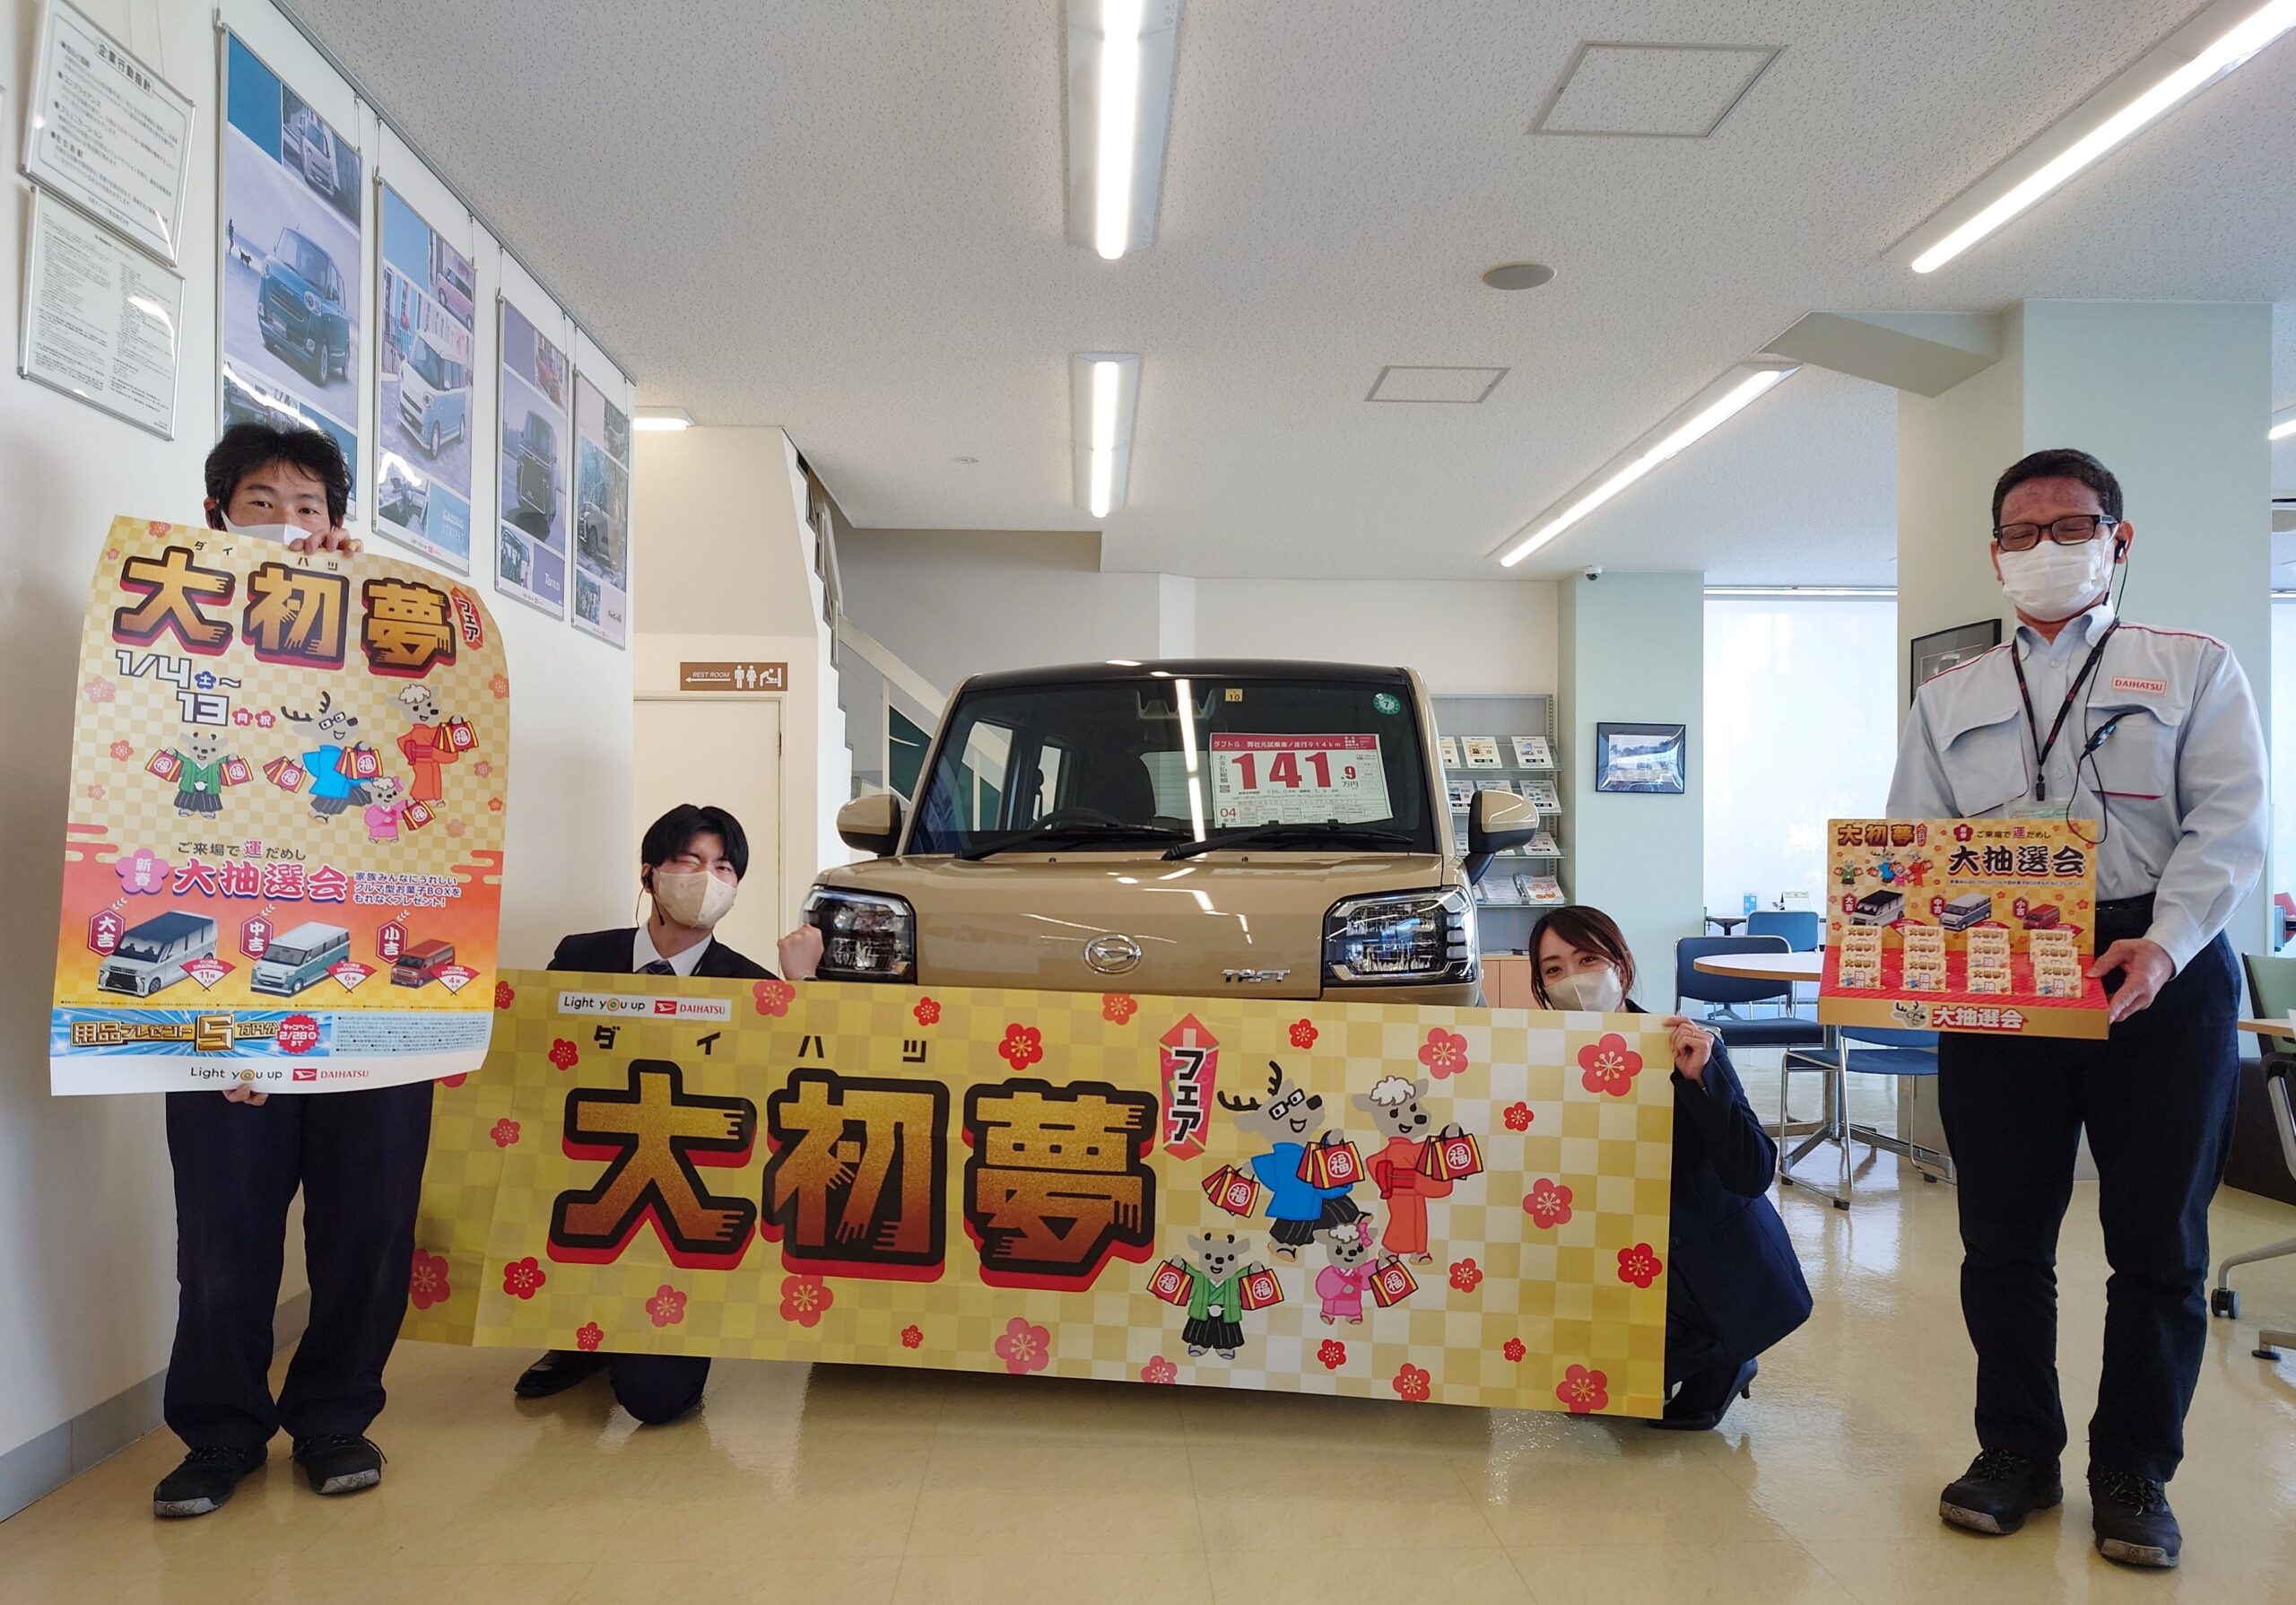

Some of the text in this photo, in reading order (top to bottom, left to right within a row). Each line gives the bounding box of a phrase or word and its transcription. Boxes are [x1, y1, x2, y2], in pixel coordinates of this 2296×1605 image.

[98, 43, 151, 93] 企業行動指針
[2114, 678, 2163, 693] DAIHATSU
[1220, 807, 1237, 818] 04
[1948, 845, 2086, 877] 大抽選会
[173, 858, 347, 903] 大抽選会
[97, 916, 117, 948] 大吉
[248, 921, 265, 952] 中吉
[384, 927, 400, 956] 小吉
[564, 996, 646, 1012] Light you up
[680, 1004, 726, 1015] DAIHATSU
[1932, 1007, 2024, 1030] 大抽選会
[190, 1067, 283, 1082] Light you up
[320, 1069, 370, 1079] DAIHATSU
[1331, 1155, 1351, 1176] 福
[1449, 1147, 1469, 1167] 福
[546, 1047, 1205, 1293] 大初夢 フェア
[1230, 1183, 1252, 1205] 福
[1160, 1271, 1178, 1292] 福
[1254, 1279, 1273, 1298] 福
[1387, 1274, 1406, 1294] 福
